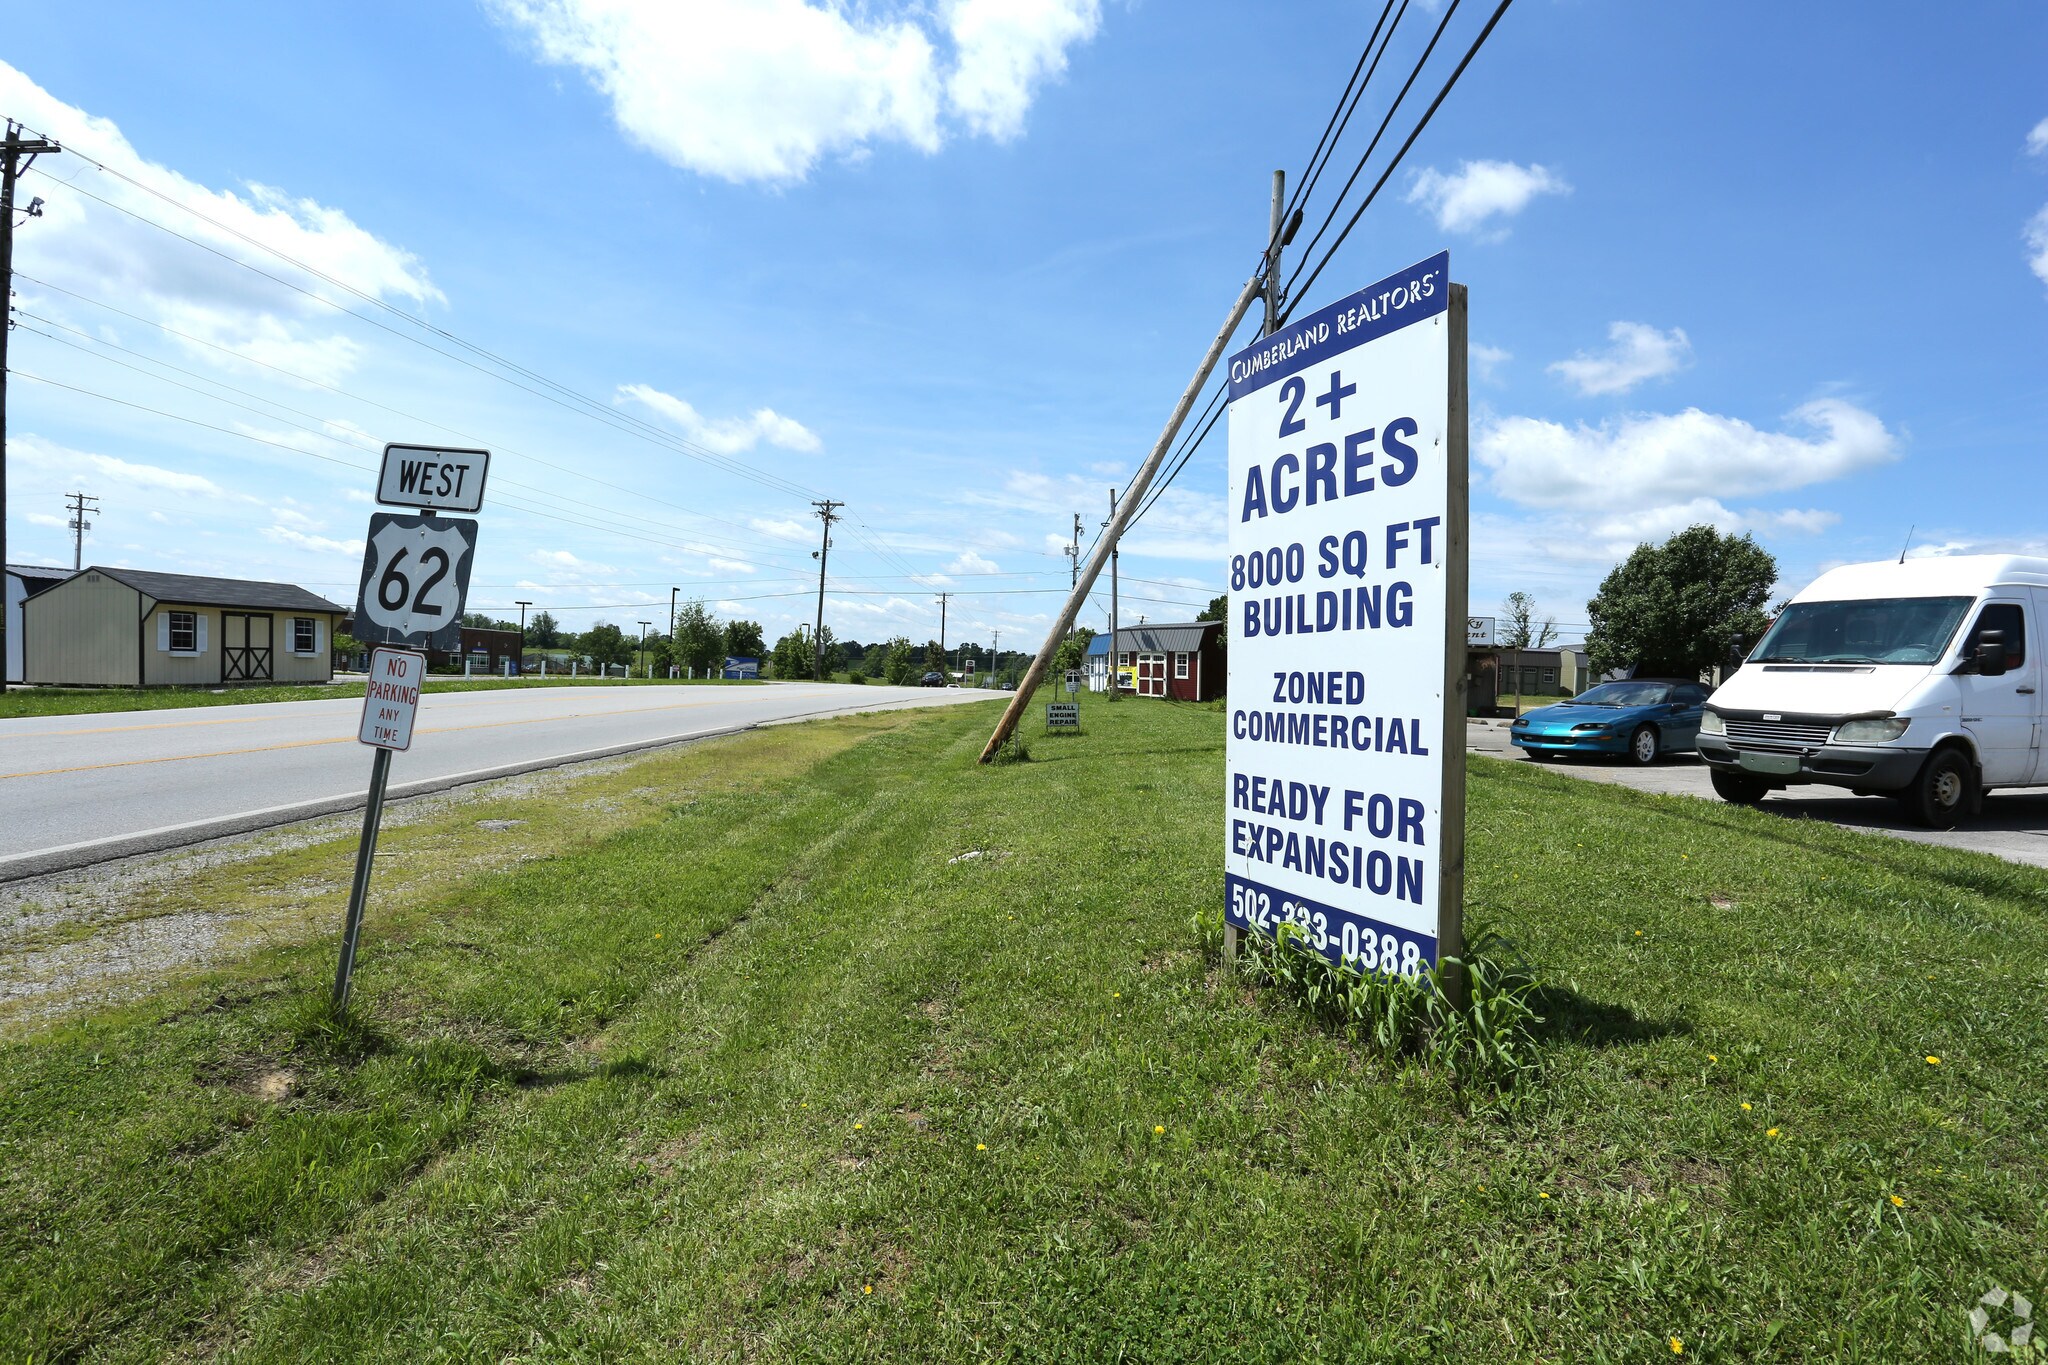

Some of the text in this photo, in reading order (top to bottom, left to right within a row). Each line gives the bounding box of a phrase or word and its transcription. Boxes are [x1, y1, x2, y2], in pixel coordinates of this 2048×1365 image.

[1231, 322, 1330, 383] CUMBERLAND
[400, 459, 470, 498] WEST
[1241, 417, 1419, 523] ACRES
[1231, 516, 1441, 591] 8000 SQ FT
[378, 546, 449, 616] 62
[1244, 581, 1413, 637] BUILDING
[368, 680, 417, 705] PARKING
[387, 658, 407, 678] NO
[1273, 671, 1365, 705] ZONED
[374, 726, 398, 741] TIME
[378, 707, 399, 721] ANY
[1233, 710, 1429, 756] COMMERCIAL
[1233, 773, 1425, 846] READY FOR
[1232, 819, 1424, 905] EXPANSION
